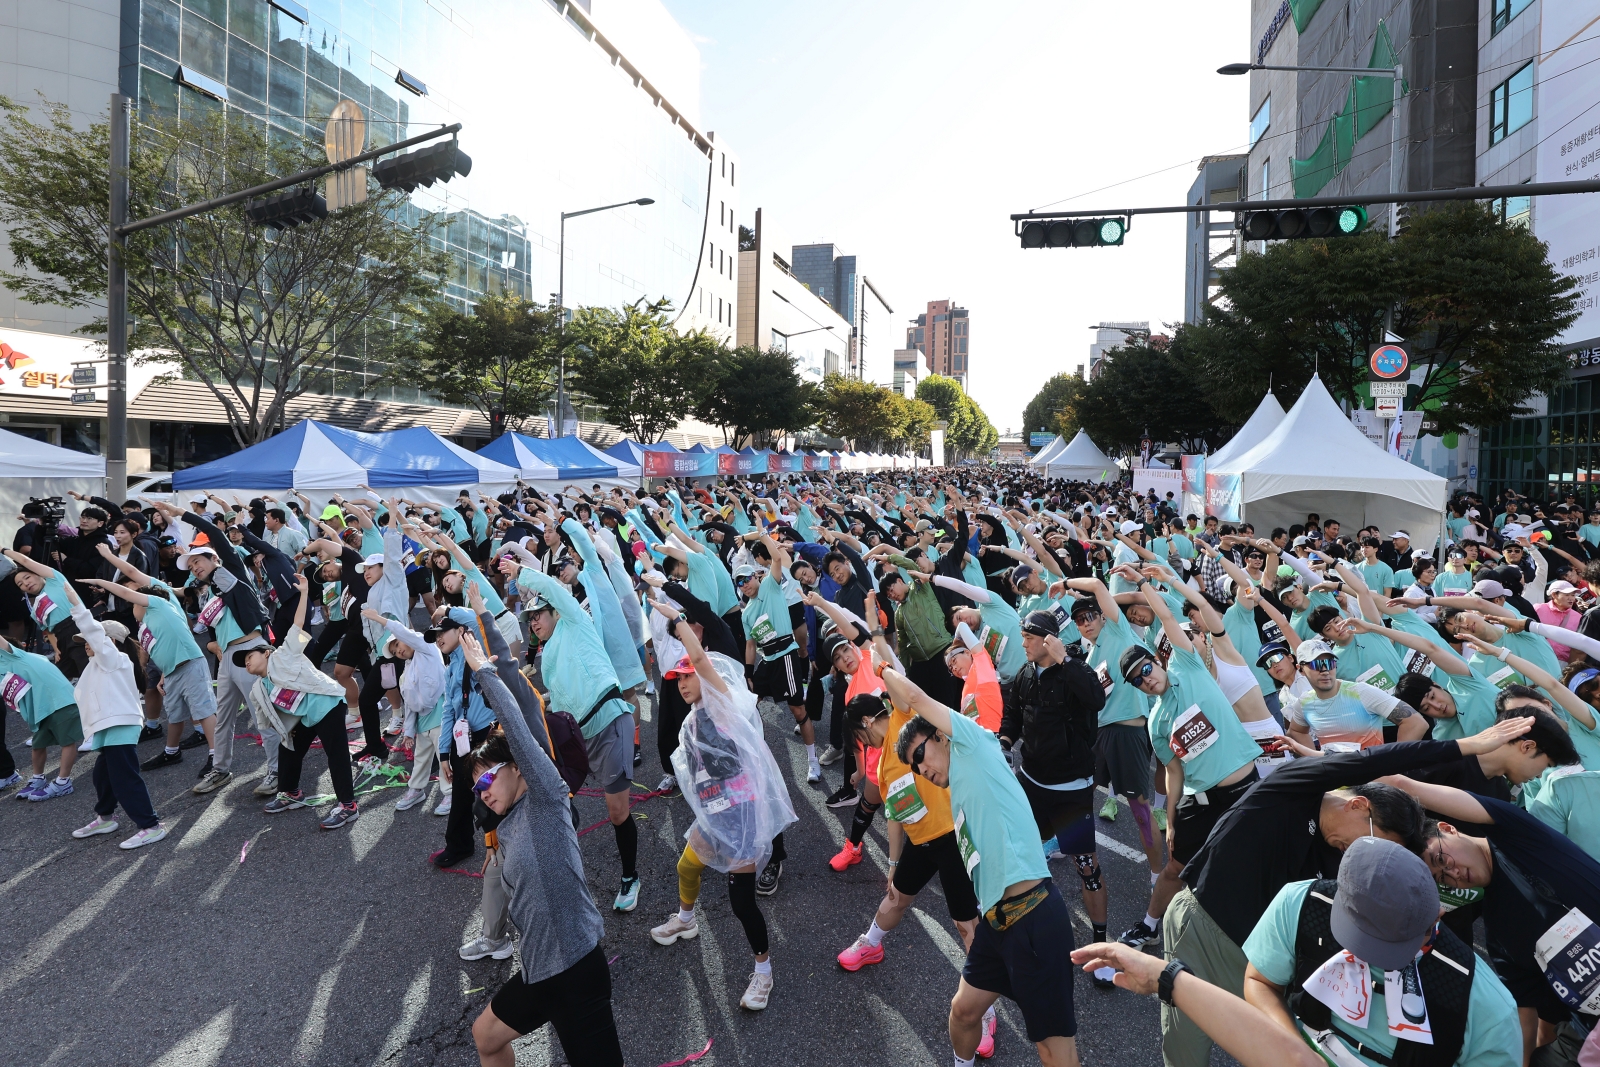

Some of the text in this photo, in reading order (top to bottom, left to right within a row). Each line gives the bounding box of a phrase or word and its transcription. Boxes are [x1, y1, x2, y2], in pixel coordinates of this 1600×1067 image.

[1562, 248, 1595, 269] 재활의학과
[674, 460, 698, 471] 종합상황실
[1411, 652, 1427, 673] 25504
[1172, 743, 1180, 752] A
[1181, 720, 1206, 744] 21523
[1552, 980, 1569, 999] B
